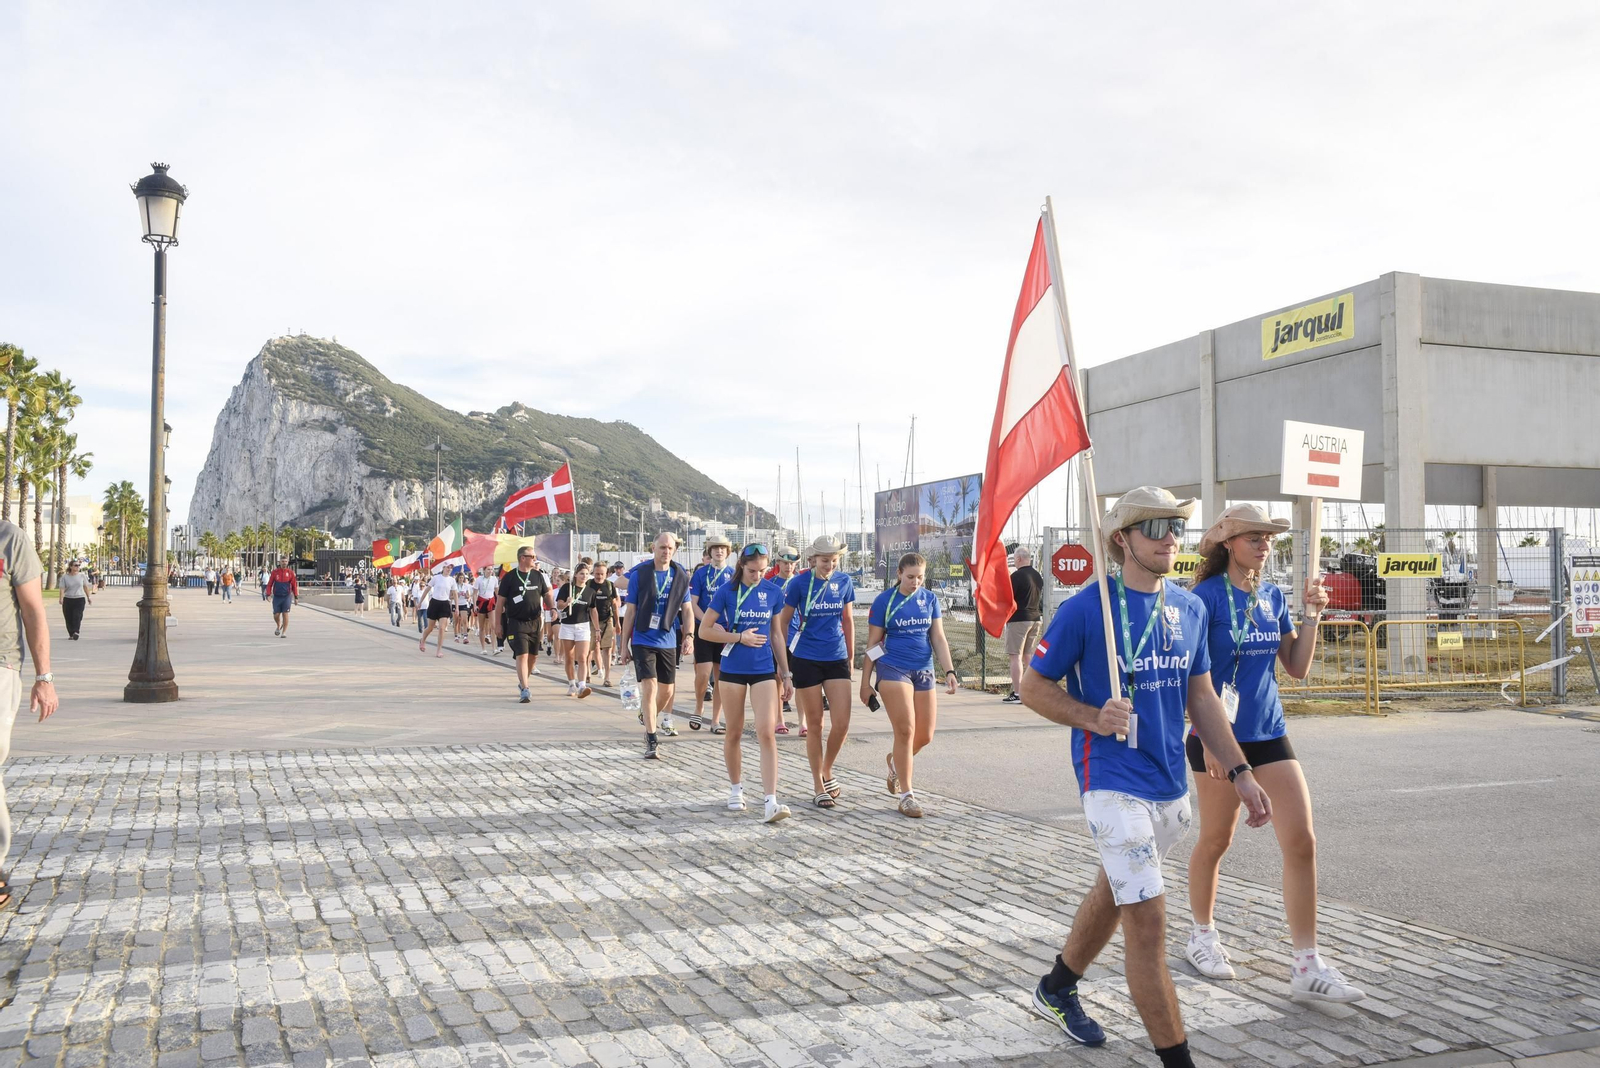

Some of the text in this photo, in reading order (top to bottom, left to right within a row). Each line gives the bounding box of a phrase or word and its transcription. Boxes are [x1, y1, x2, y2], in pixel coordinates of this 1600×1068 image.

[1271, 302, 1344, 353] jarquil
[1302, 433, 1347, 453] AUSTRIA
[893, 514, 917, 526] COMERCIAL
[1058, 558, 1087, 571] STOP
[1383, 557, 1437, 574] jarquil
[895, 615, 932, 627] Verbund
[1120, 682, 1138, 691] As
